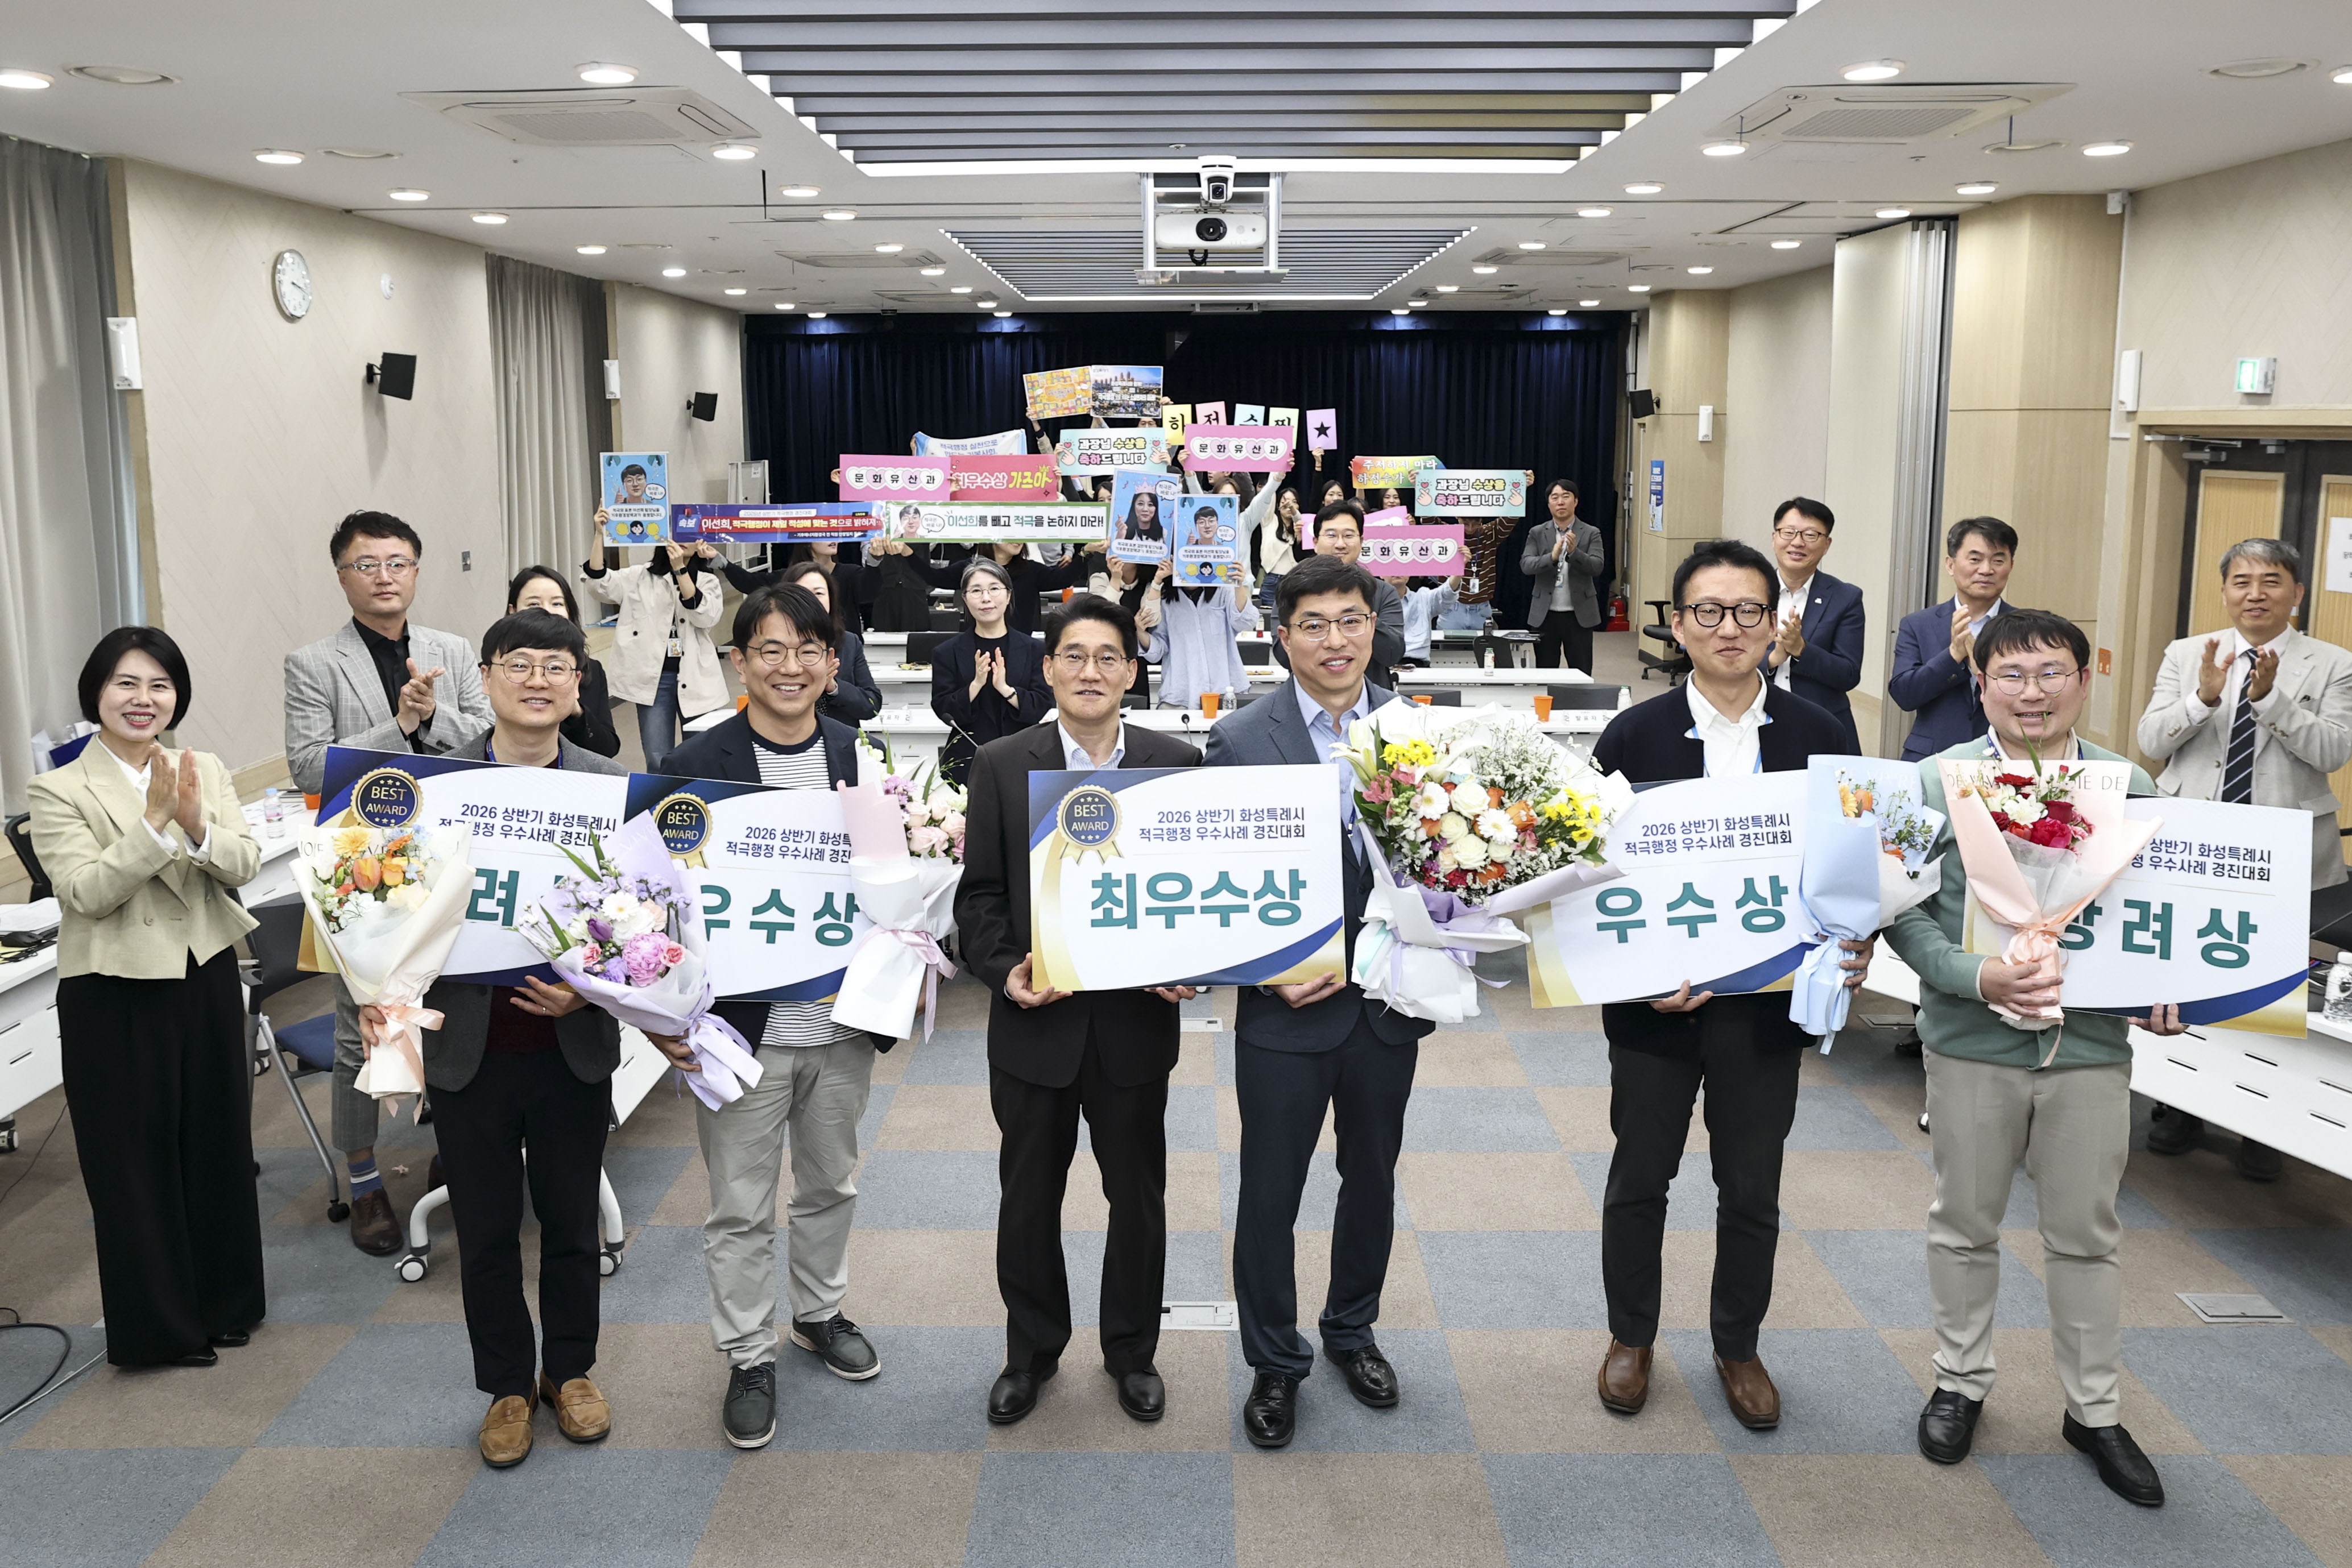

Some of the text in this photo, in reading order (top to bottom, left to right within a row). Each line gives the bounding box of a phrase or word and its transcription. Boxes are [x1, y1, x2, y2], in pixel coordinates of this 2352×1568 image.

[940, 439, 999, 451] 적극행정 실천으로
[1078, 437, 1146, 450] 과장님 수상을
[1199, 443, 1279, 455] 문화유산과
[1078, 452, 1147, 466] 축하드립니다
[1363, 459, 1438, 471] 주저하지 마라
[855, 473, 935, 484] 문화유산과
[1357, 472, 1405, 485] 하정수가
[1435, 478, 1506, 491] 과장님 수상을
[1435, 493, 1506, 507] 축하드립니다
[678, 518, 697, 528] 속보
[701, 518, 732, 530] 이선희,
[732, 520, 770, 529] 적극행정이
[771, 519, 788, 529] 제일
[788, 518, 811, 528] 적성에
[812, 518, 829, 528] 맞는
[829, 518, 852, 528] 것으로
[947, 515, 1104, 527] 이선희를 빼고 적극을 논하지 마라!
[1361, 546, 1448, 557] 문화유산과
[2102, 775, 2125, 791] DE
[371, 786, 407, 802] BEST
[366, 802, 408, 816] AWARD
[1074, 804, 1106, 818] BEST
[1157, 807, 1305, 824] 2026 상반기 화성특례시
[461, 803, 616, 832] 2026 상반기 화성특례시
[666, 811, 698, 826] BEST
[1642, 812, 1790, 837] 2026 상반기 화성특례시
[1071, 820, 1109, 832] AWARD
[1139, 824, 1306, 842] 적극행정 우수사례 경진대회
[500, 824, 554, 843] 우수사례
[662, 828, 699, 841] AWARD
[745, 827, 851, 847] 2026 상반기 화성특
[1625, 829, 1792, 856] 적극행정 우수사례 경진대회
[726, 840, 851, 864] 적극행정 우수사례 경진
[2150, 838, 2271, 864] 상반기 화성특례시
[2149, 856, 2206, 875] 우수사례
[2212, 862, 2271, 882] 경진대회
[1090, 868, 1307, 930] 최우수상
[701, 885, 860, 947] 우수상
[1595, 875, 1788, 944] 우수상
